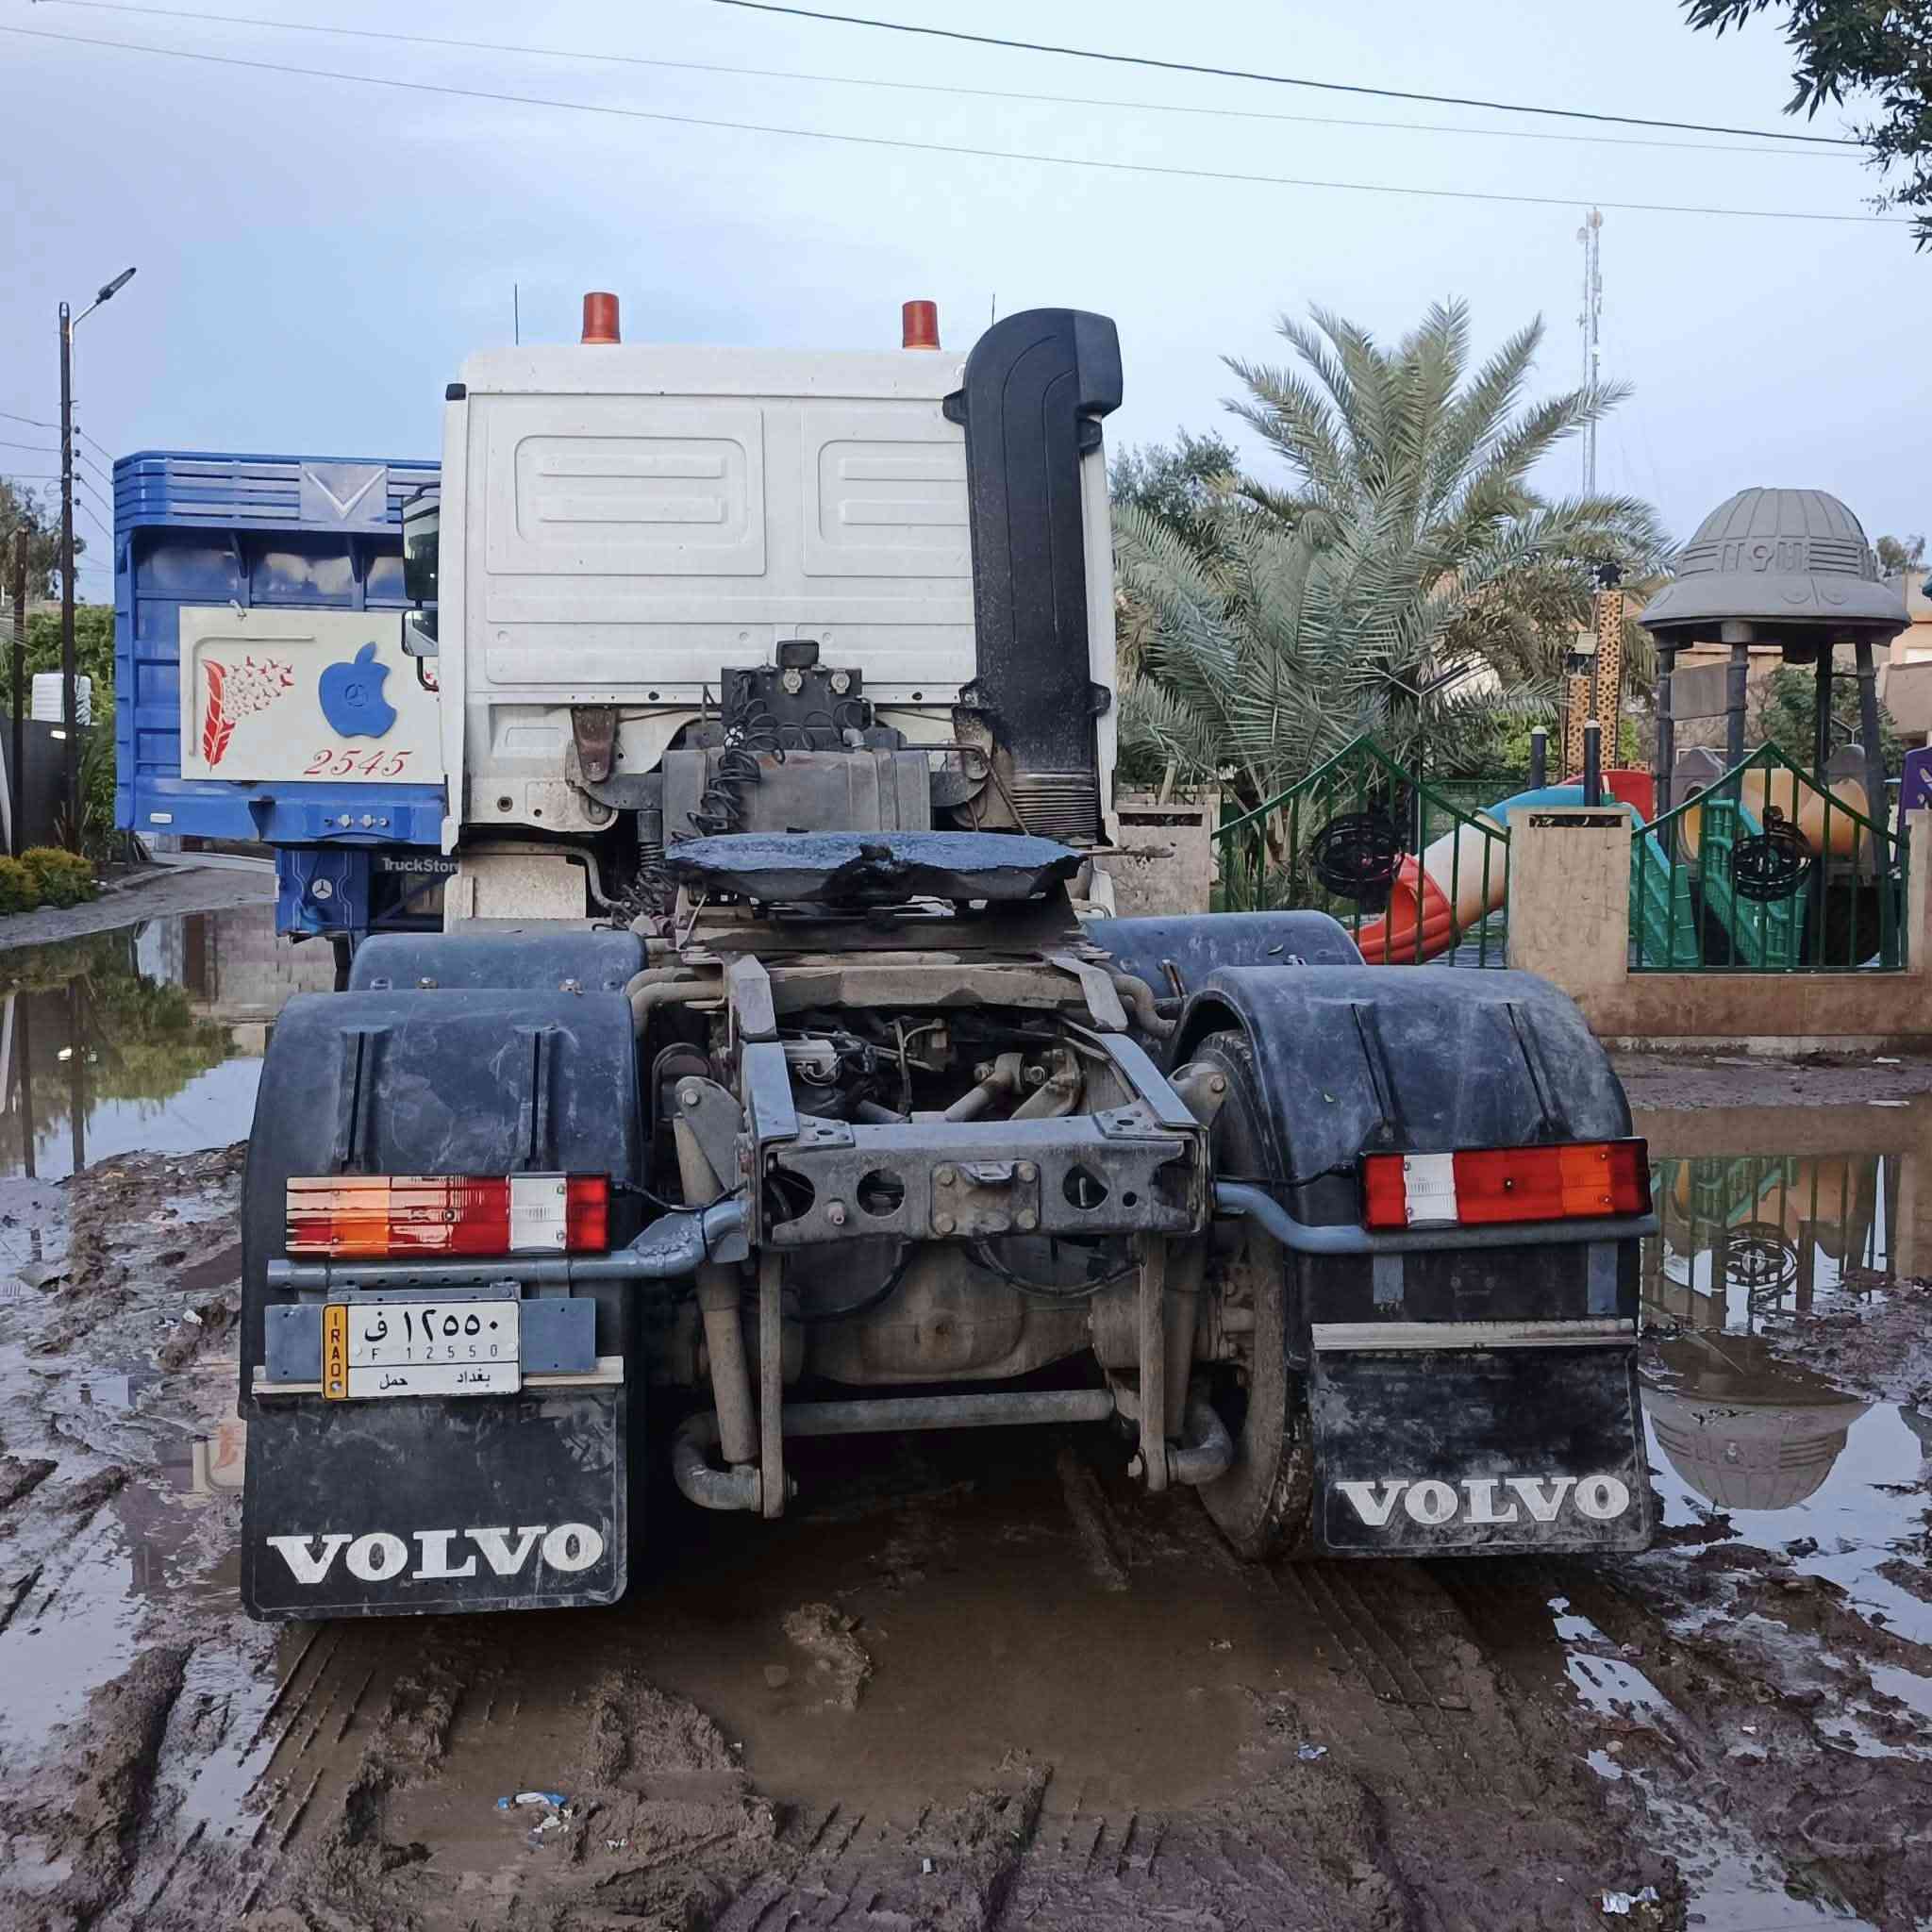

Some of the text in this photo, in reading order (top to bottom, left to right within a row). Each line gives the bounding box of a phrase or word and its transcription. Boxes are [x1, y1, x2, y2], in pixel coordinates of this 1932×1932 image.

[303, 749, 413, 776] 2545
[382, 857, 460, 873] TruckStor
[364, 1308, 499, 1342] ف ١٢٥٥٠
[372, 1343, 498, 1360] F 12550
[378, 1367, 491, 1390] بغداد حمل
[1335, 1474, 1630, 1526] VOLVO
[266, 1523, 604, 1584] VOLVO
